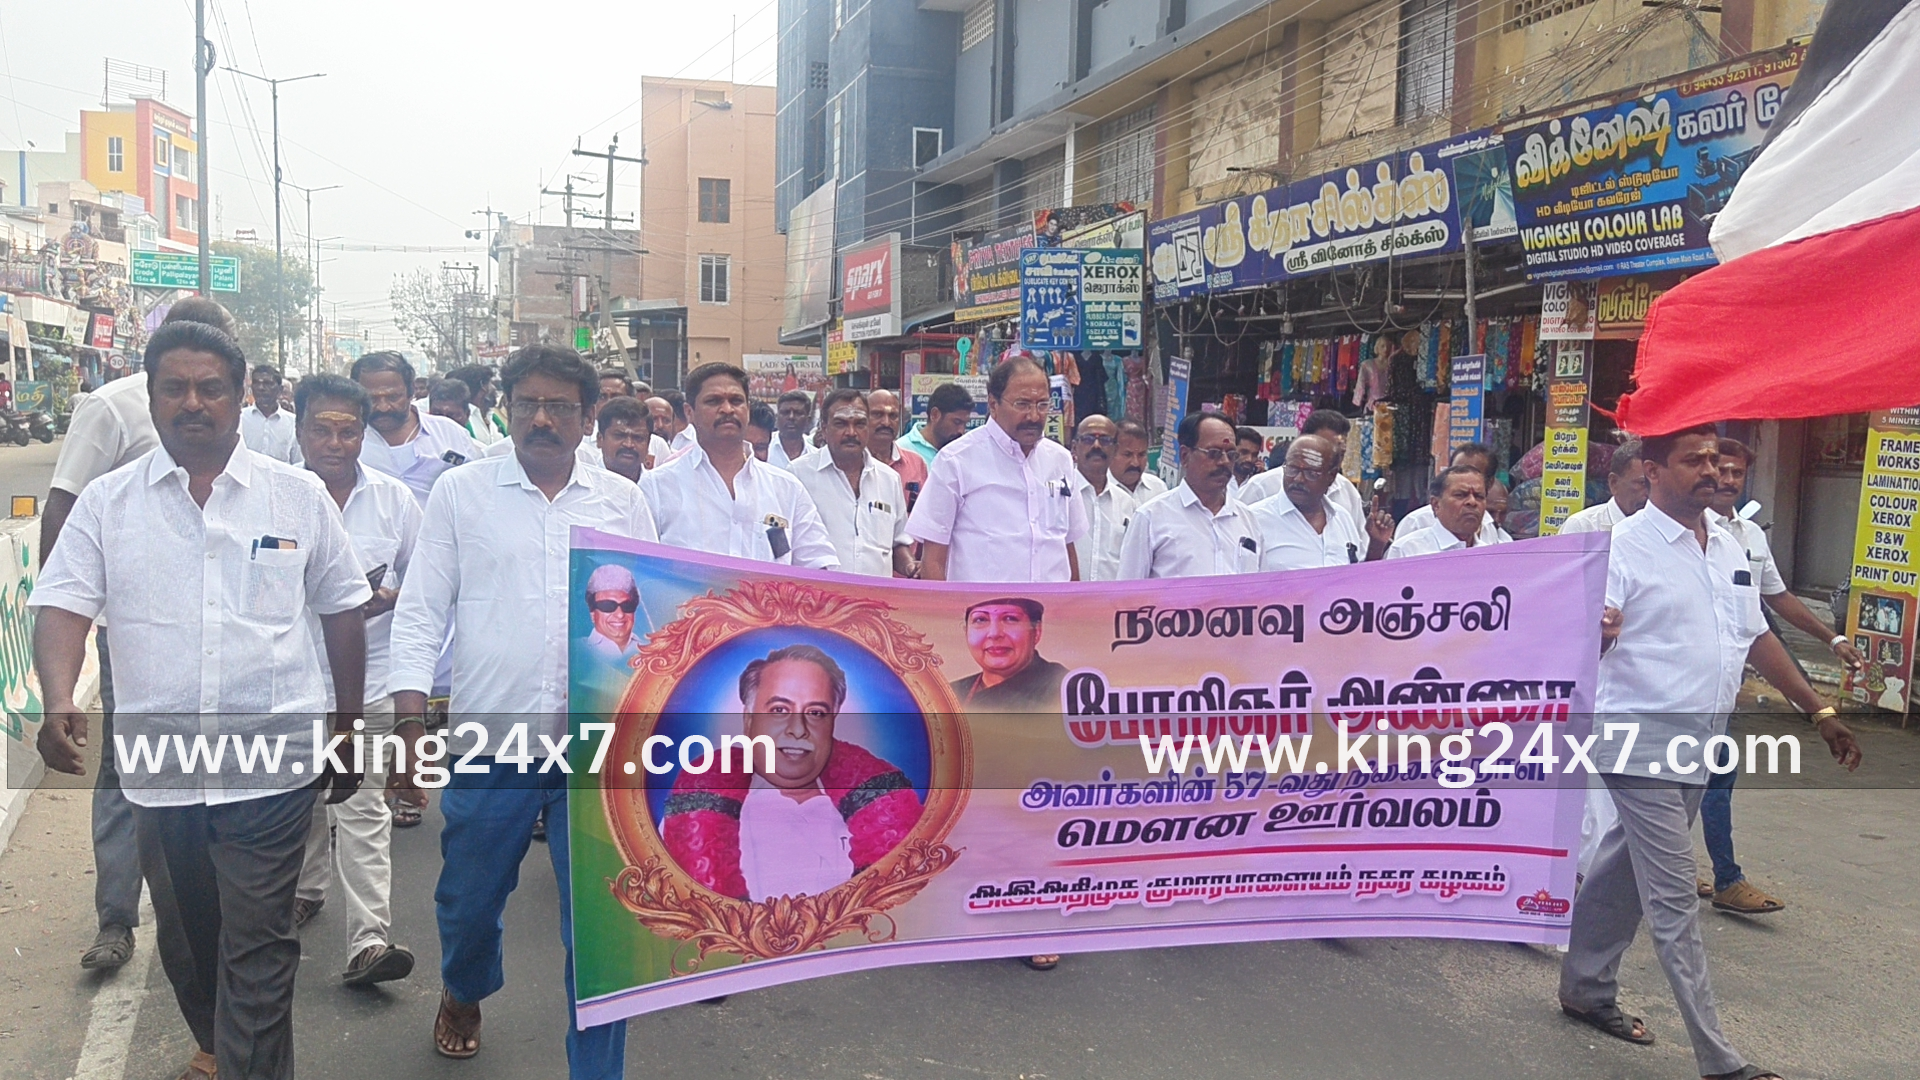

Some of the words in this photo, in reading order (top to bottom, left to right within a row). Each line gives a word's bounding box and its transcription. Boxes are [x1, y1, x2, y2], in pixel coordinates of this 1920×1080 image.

[1677, 93, 1746, 140] கலர்
[1571, 176, 1616, 199] டிஜிட்டல்
[1536, 206, 1551, 218] HD
[1553, 198, 1594, 215] வீடியோ
[1596, 189, 1642, 208] கவரேஜ்
[1520, 220, 1582, 251] VIGNESH
[1584, 209, 1648, 242] COLOUR
[1651, 204, 1684, 232] LAB
[1311, 238, 1377, 265] வினோத்
[1380, 225, 1445, 252] சில்க்ஸ்
[1526, 250, 1558, 265] DIGITAL
[1558, 246, 1589, 262] STUDIO
[1590, 243, 1604, 257] HD
[1604, 239, 1633, 255] VIDEO
[1634, 233, 1685, 252] COVERAGE
[1083, 266, 1140, 279] XEROX
[1084, 279, 1140, 294] ஜெராக்ஸ்
[1890, 407, 1919, 415] WITHIN
[1880, 439, 1920, 454] FRAME
[1877, 455, 1920, 470] WORKS
[1554, 476, 1571, 486] கலர்
[1544, 487, 1580, 499] ஜெராக்ஸ்
[1553, 506, 1569, 514] B&W
[1869, 495, 1918, 512] COLOUR
[1871, 511, 1912, 527] XEROX
[1874, 531, 1904, 546] B&W
[1865, 546, 1909, 563] XEROX
[1854, 565, 1890, 582] PRINT
[1891, 571, 1917, 586] OUT
[1111, 604, 1304, 652] நினைவு
[1319, 586, 1512, 640] அஞ்சலி
[1327, 666, 1576, 734] அண்ணா
[1022, 766, 1216, 809] அவர்களின்
[1057, 811, 1257, 848] மௌன
[1263, 788, 1501, 832] ஊர்வலம்
[968, 876, 1139, 911] அஇஅதிமுக
[1146, 864, 1352, 903] குமாரபாளையம்
[1355, 869, 1415, 897] நகர
[1420, 864, 1506, 898] கழகம்
